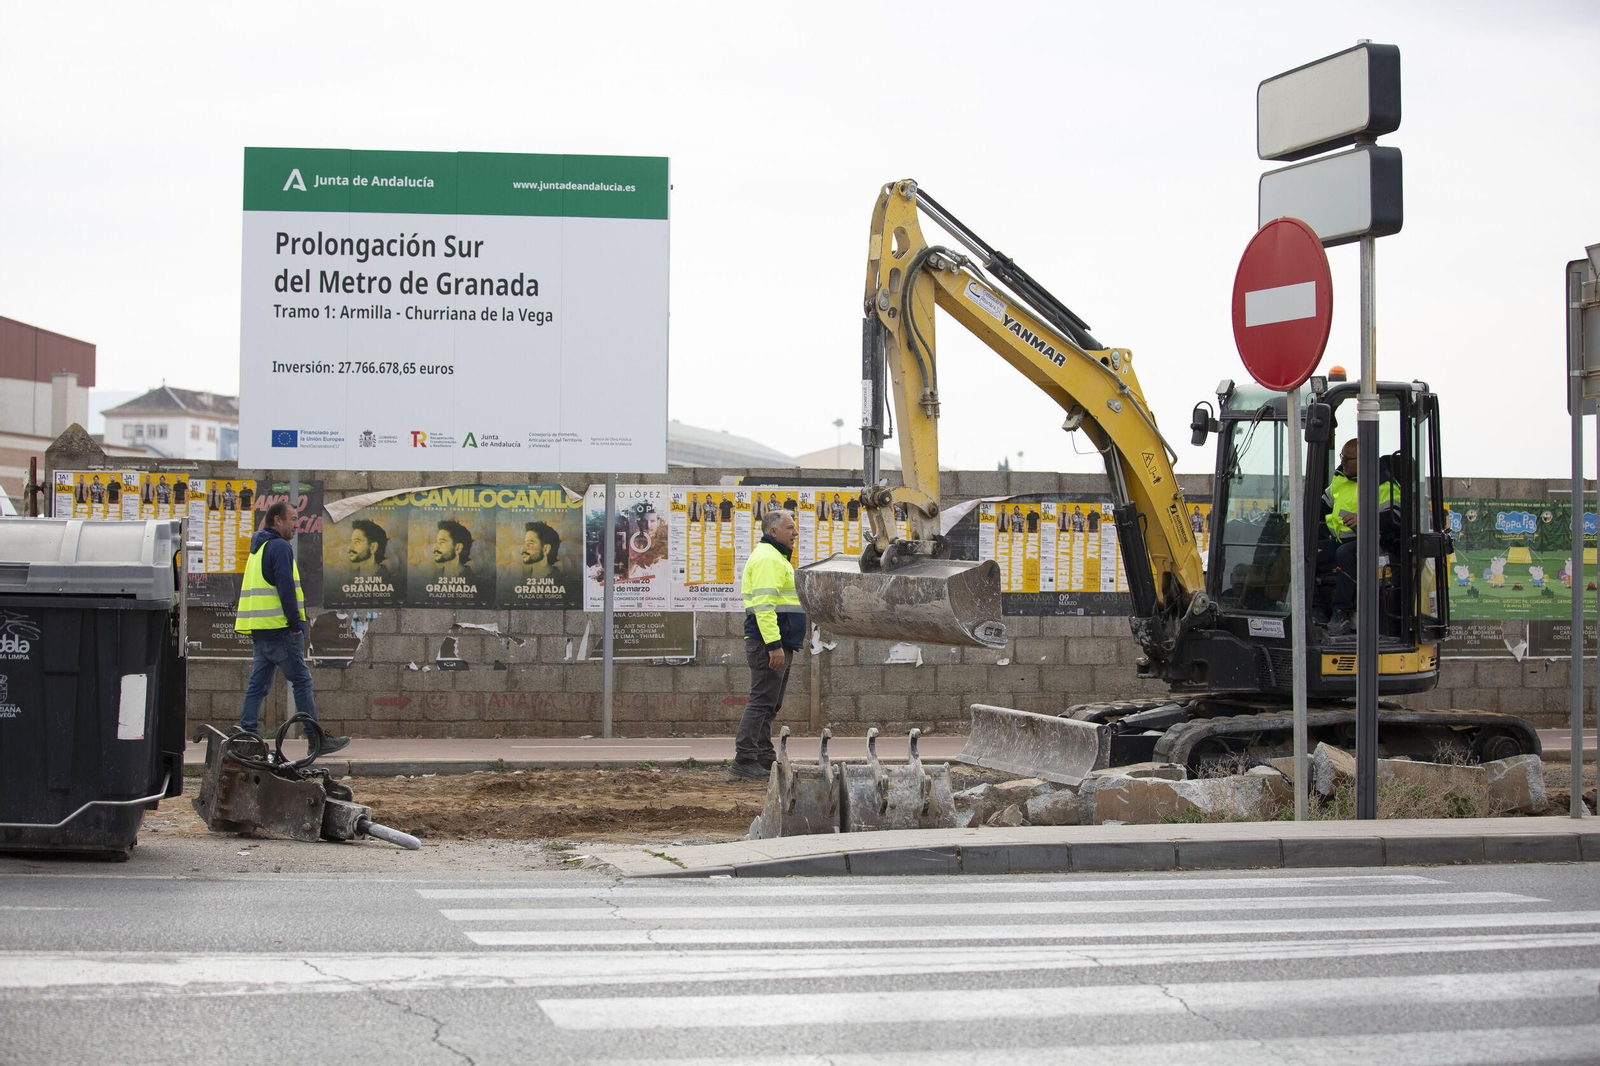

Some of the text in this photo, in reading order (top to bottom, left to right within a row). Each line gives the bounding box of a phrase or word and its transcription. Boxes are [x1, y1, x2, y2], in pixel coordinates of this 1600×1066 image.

[314, 174, 434, 188] Junta de Andalucía
[512, 180, 636, 192] www.juntadeandalucia.es
[276, 232, 484, 263] Prolongación Sur
[274, 268, 539, 297] del Metro de Granada
[274, 304, 320, 318] Tramo
[324, 305, 336, 319] 1:
[340, 305, 392, 320] Armilla
[405, 306, 476, 320] Churriana
[480, 307, 498, 321] de
[502, 307, 514, 322] la
[518, 308, 553, 326] Vega
[1002, 314, 1067, 367] YANMAR
[272, 361, 454, 376] Inversión: 27.766.678,65 euros
[1497, 514, 1536, 530] Peppa Pig
[342, 584, 394, 592] GRANADA
[426, 584, 478, 593] GRANADA
[514, 586, 566, 594] GRANADA
